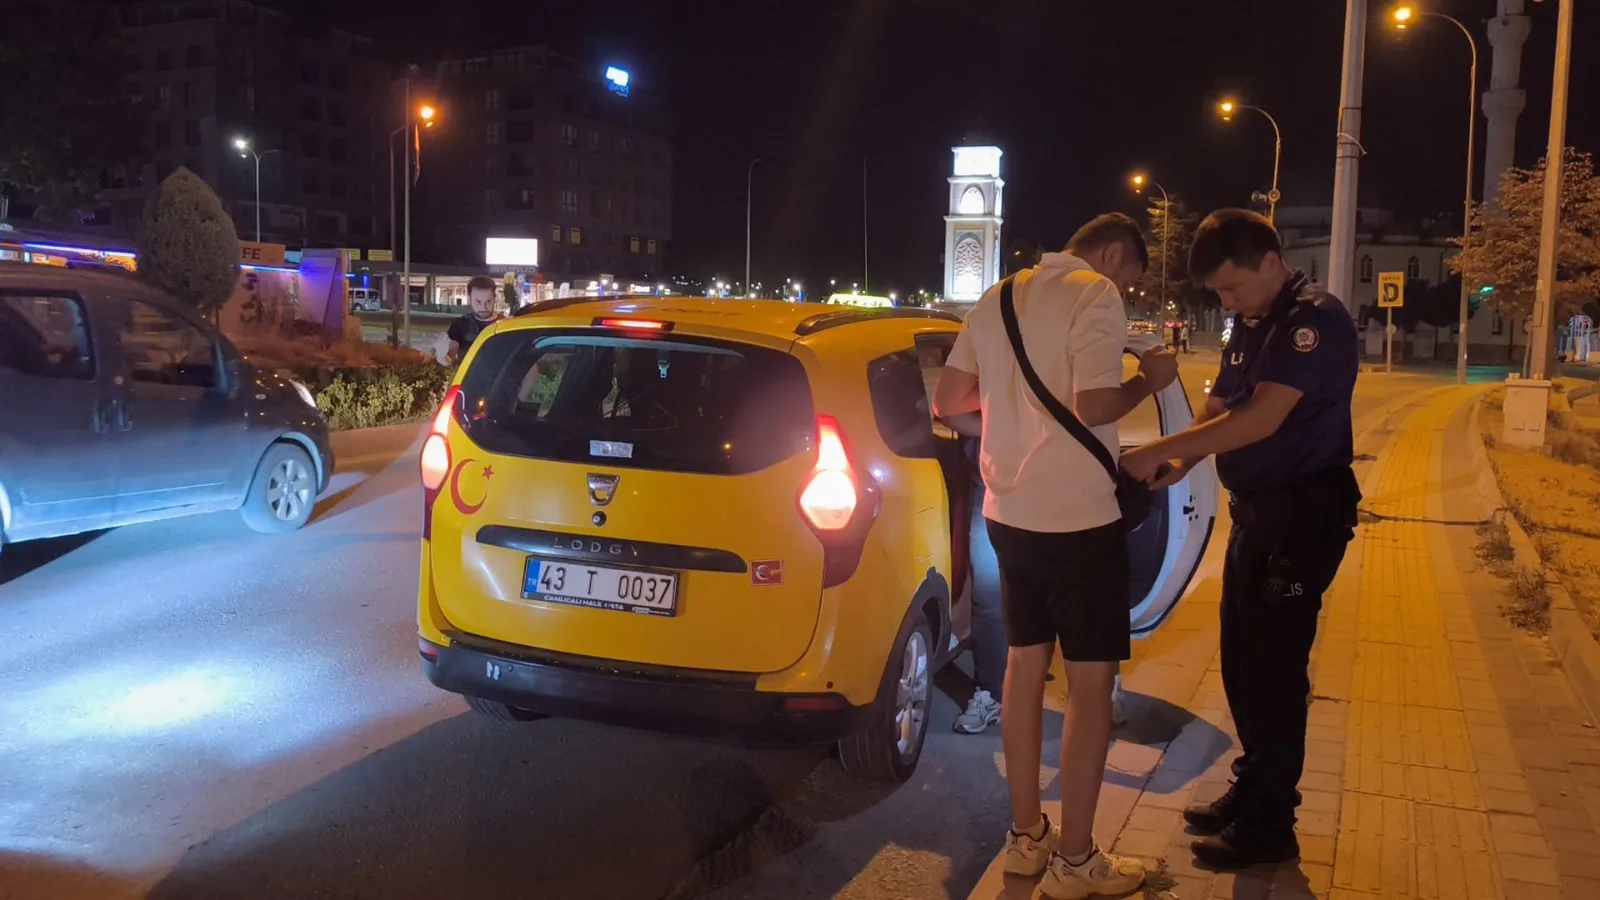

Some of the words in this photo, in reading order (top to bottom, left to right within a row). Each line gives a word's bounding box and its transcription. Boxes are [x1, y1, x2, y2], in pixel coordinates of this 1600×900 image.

[1384, 282, 1399, 302] D
[527, 578, 537, 587] TR
[541, 565, 566, 591] 43
[587, 570, 597, 595] T
[618, 575, 671, 604] 0037
